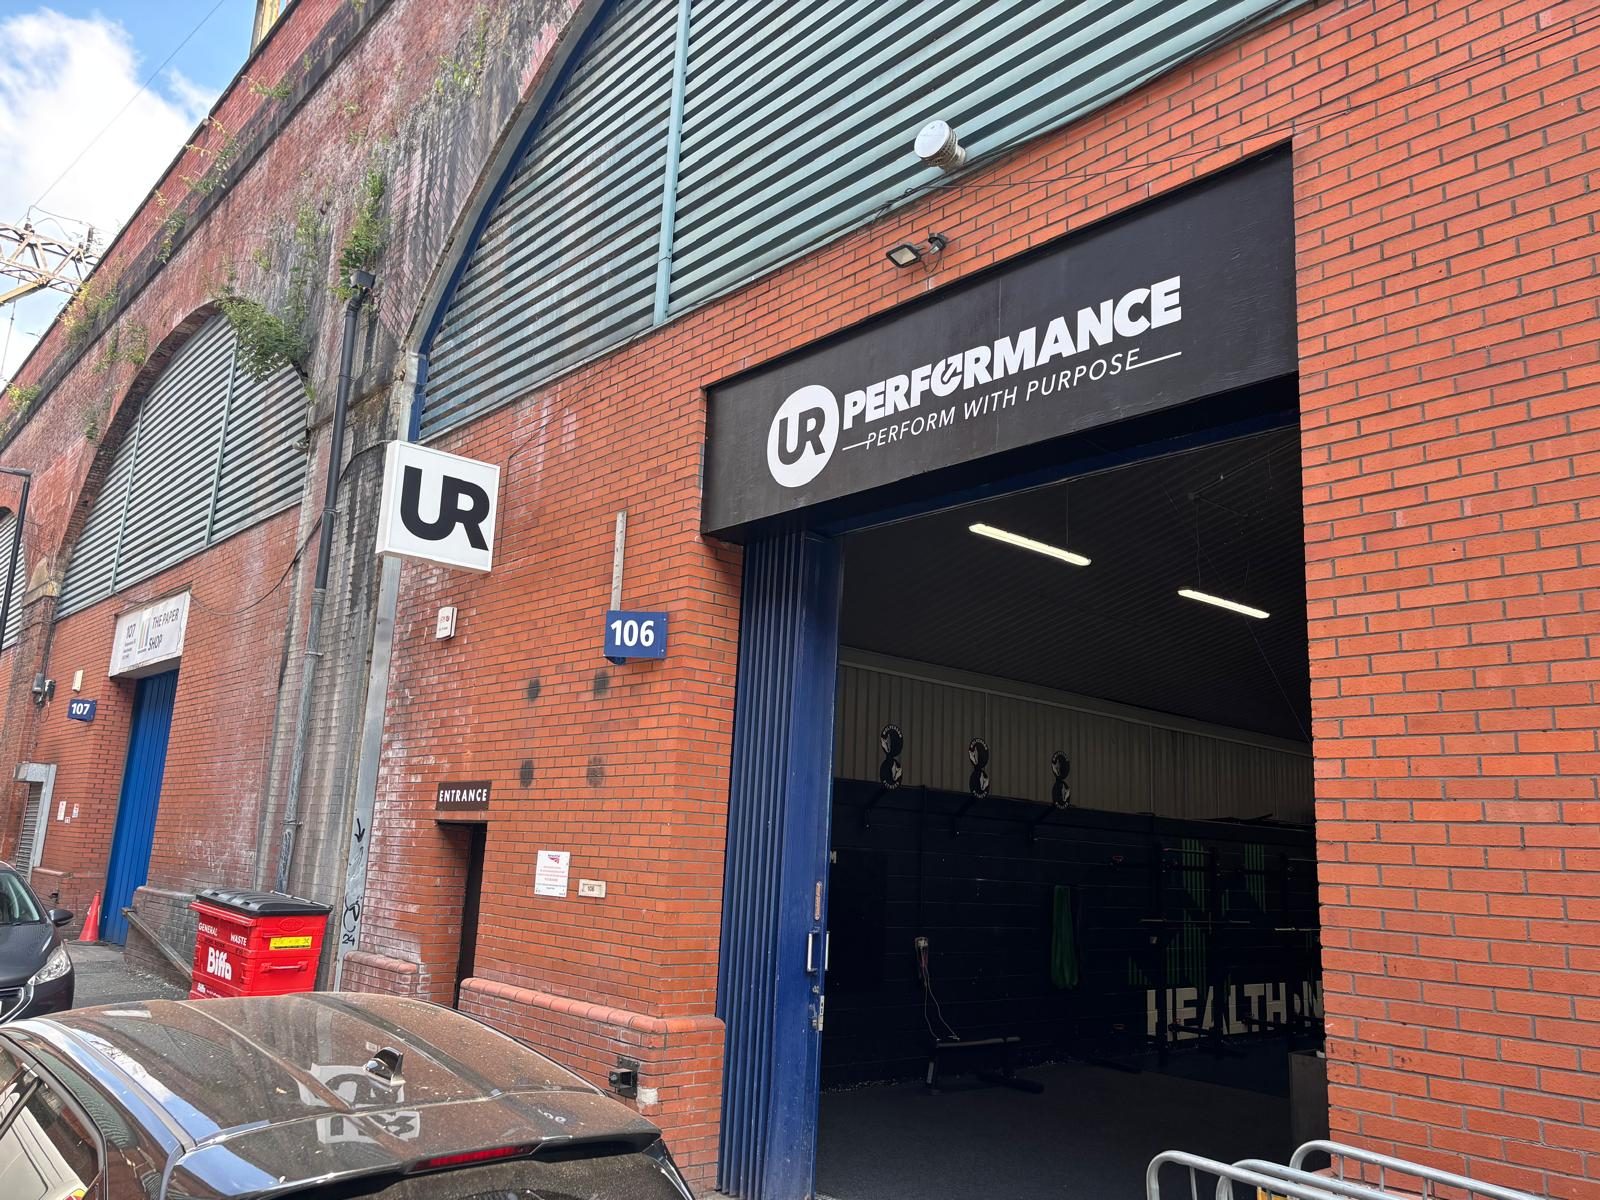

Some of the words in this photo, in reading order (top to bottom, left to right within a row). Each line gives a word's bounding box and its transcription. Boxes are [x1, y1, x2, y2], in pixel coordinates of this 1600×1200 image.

[778, 405, 826, 466] UR
[842, 275, 1182, 430] PERFORMANCE
[866, 405, 956, 450] PERFORM
[963, 386, 1018, 421] WITH
[1025, 347, 1141, 403] PURPOSE
[400, 465, 491, 551] UR
[152, 612, 163, 629] THE
[162, 608, 180, 627] PAPER
[148, 634, 163, 651] SHOP
[610, 620, 655, 647] 106
[71, 702, 91, 715] 107
[439, 788, 488, 802] ENTRANCE
[198, 922, 218, 937] GENERAL
[230, 933, 247, 946] WASTE
[342, 933, 355, 947] 24
[206, 947, 232, 981] Biffa
